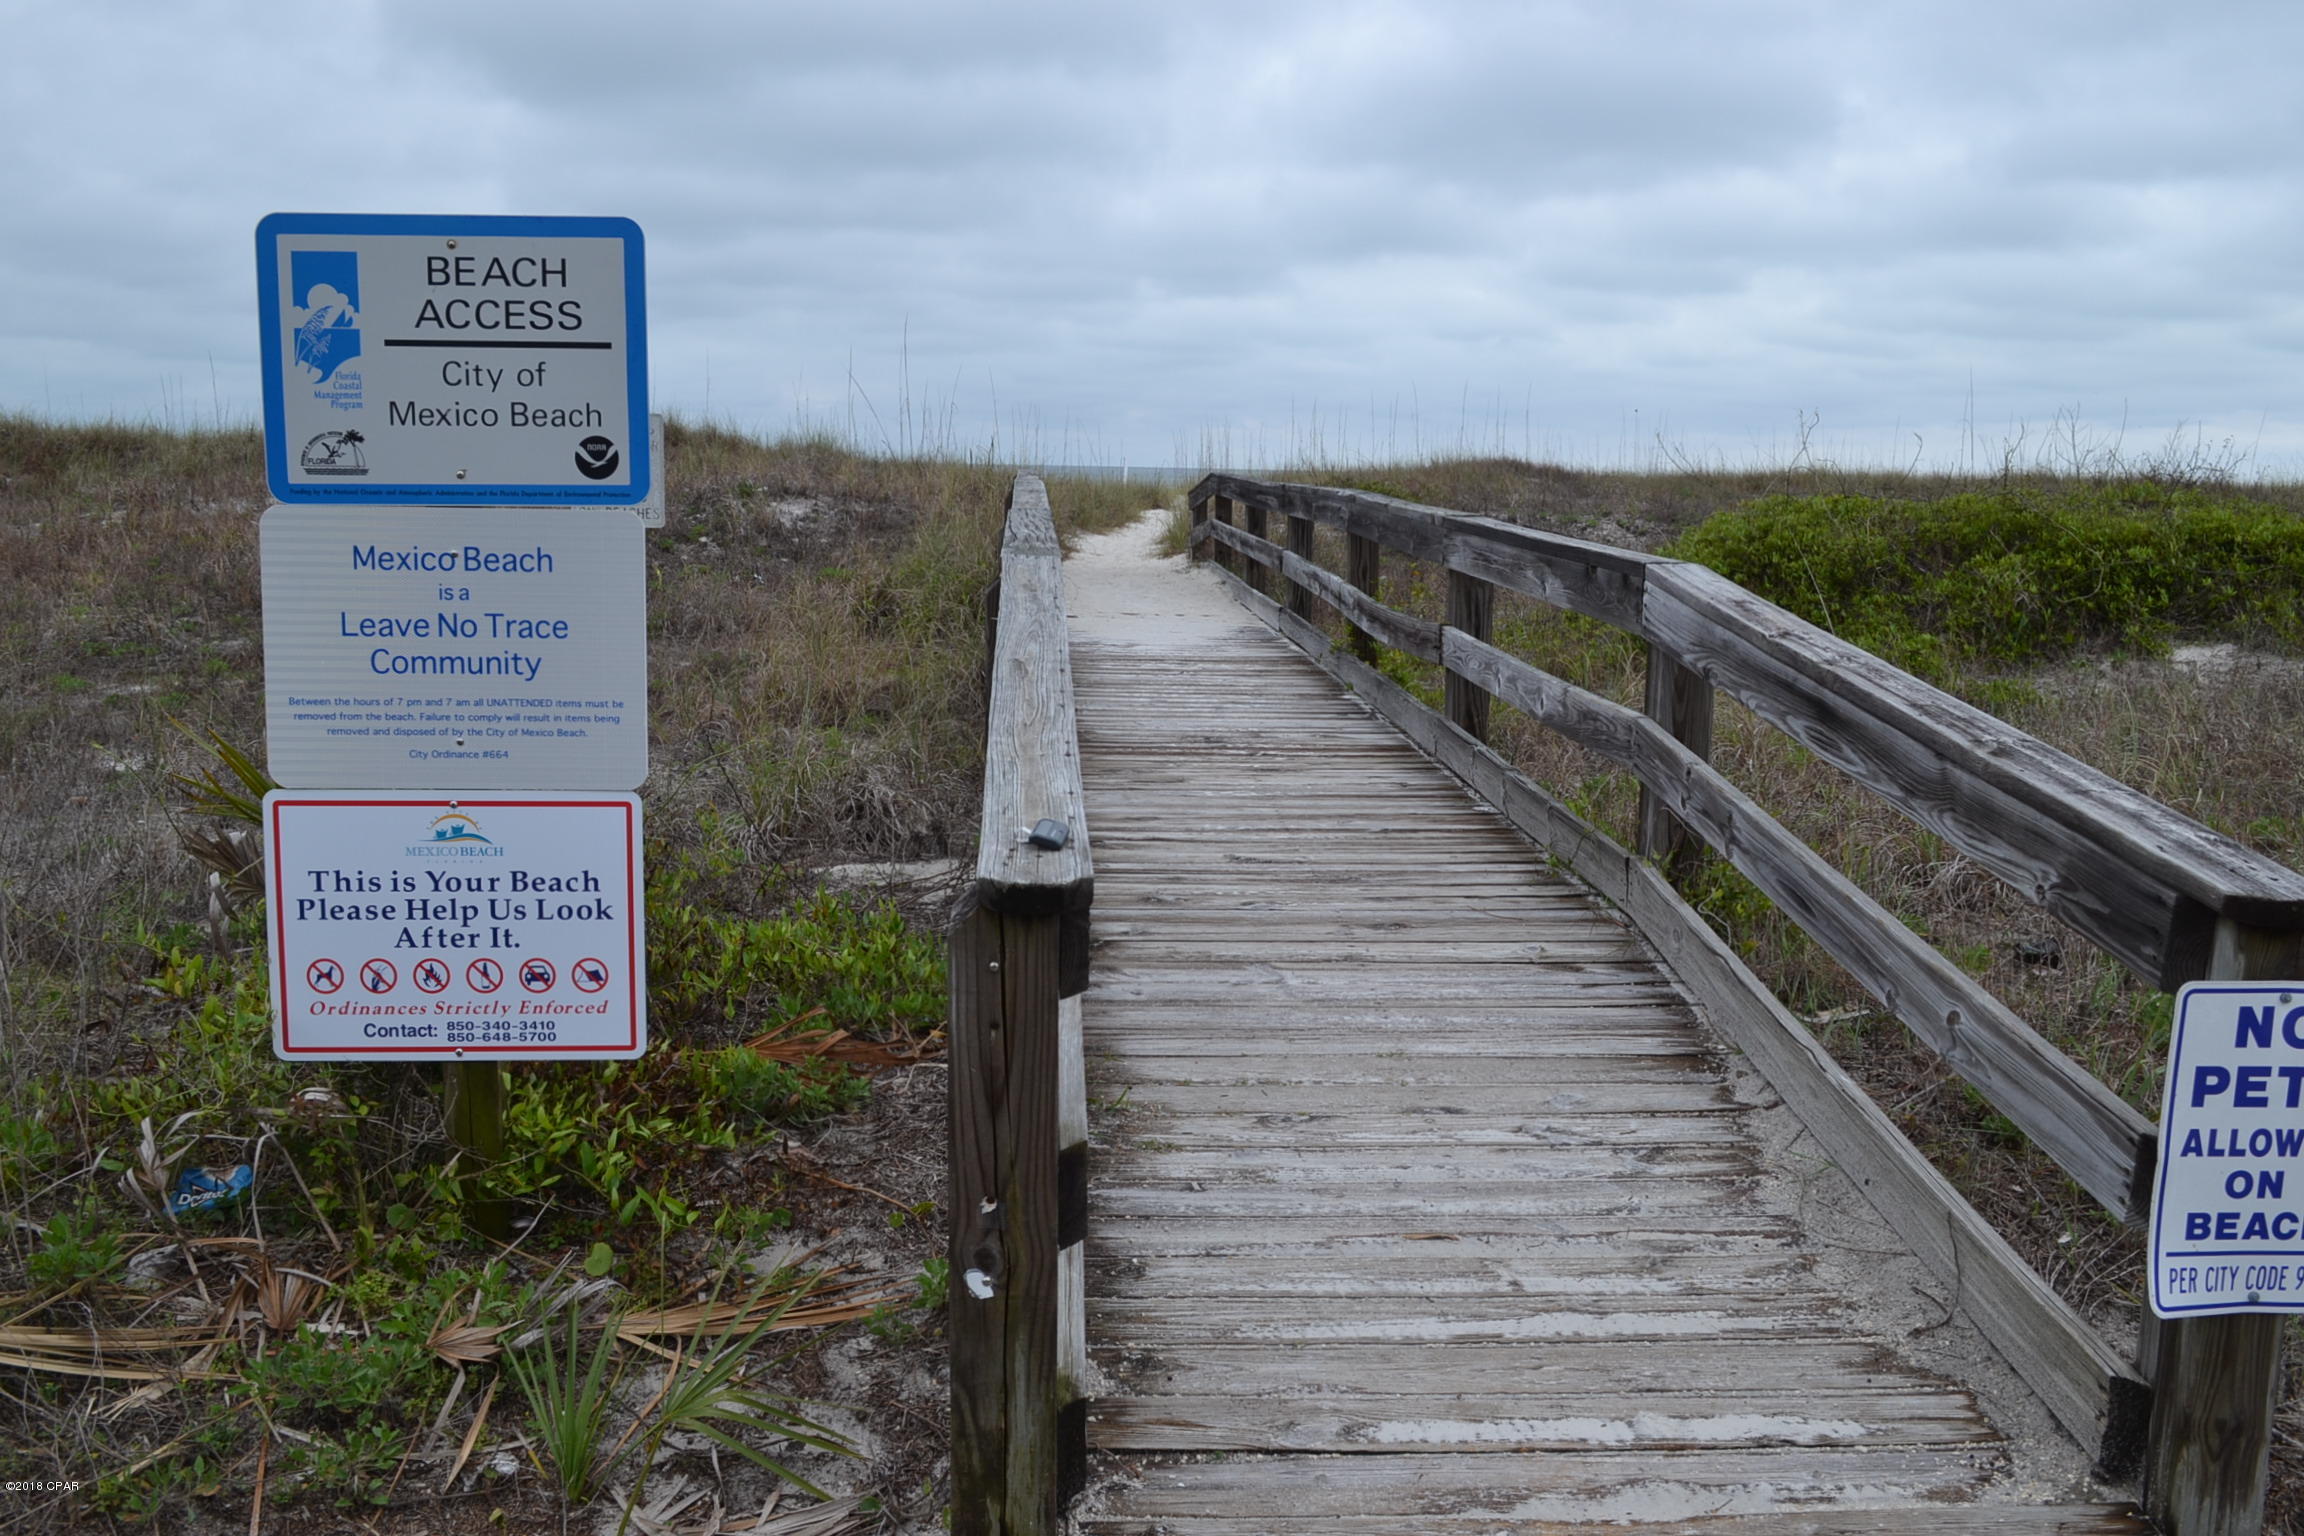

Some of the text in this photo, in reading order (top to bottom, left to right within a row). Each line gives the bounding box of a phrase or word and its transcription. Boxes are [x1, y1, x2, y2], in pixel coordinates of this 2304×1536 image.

[427, 256, 567, 287] BEACH
[415, 299, 583, 331] ACCESS
[335, 370, 361, 380] Florida
[442, 361, 547, 392] City of
[314, 390, 362, 400] Management
[333, 381, 362, 390] Coastal
[331, 400, 363, 410] Program
[389, 401, 602, 428] Mexico Beach
[307, 457, 336, 465] FLORIDA
[353, 545, 553, 573] Mexico Beach
[439, 584, 470, 601] is a
[341, 612, 569, 640] Leave No Trace
[371, 649, 542, 681] Community
[288, 697, 331, 706] Between
[334, 697, 350, 706] the
[353, 697, 380, 706] hours
[384, 697, 394, 706] of
[397, 698, 403, 706] 7
[407, 699, 422, 708] pm
[425, 698, 443, 707] and
[446, 699, 452, 707] 7
[473, 698, 484, 707] all
[486, 698, 553, 708] UNATTENDED
[555, 699, 582, 708] items
[585, 699, 609, 709] must
[612, 700, 624, 709] be
[294, 712, 620, 725] removed from the beach. Failure to comply will result in items being
[327, 727, 588, 738] removed and disposed of by the City of Mexico Beach.
[409, 749, 509, 760] City Ordinance #664
[405, 846, 504, 857] MEXICO BEACH
[308, 870, 600, 893] This is Your Beach
[296, 898, 614, 927] Please Help Us Look
[394, 926, 521, 949] After It.
[309, 1000, 609, 1018] Ordinances Strictly Enforced
[363, 1021, 556, 1038] Contact: 850-340-3410
[446, 1032, 557, 1043] 850-648-5700
[2180, 1128, 2304, 1158] ALLOW
[2225, 1170, 2285, 1200] ON
[2185, 1212, 2304, 1241] BEAC
[2169, 1267, 2198, 1294] PER
[2205, 1266, 2240, 1292] CITY
[2245, 1265, 2289, 1291] CODE
